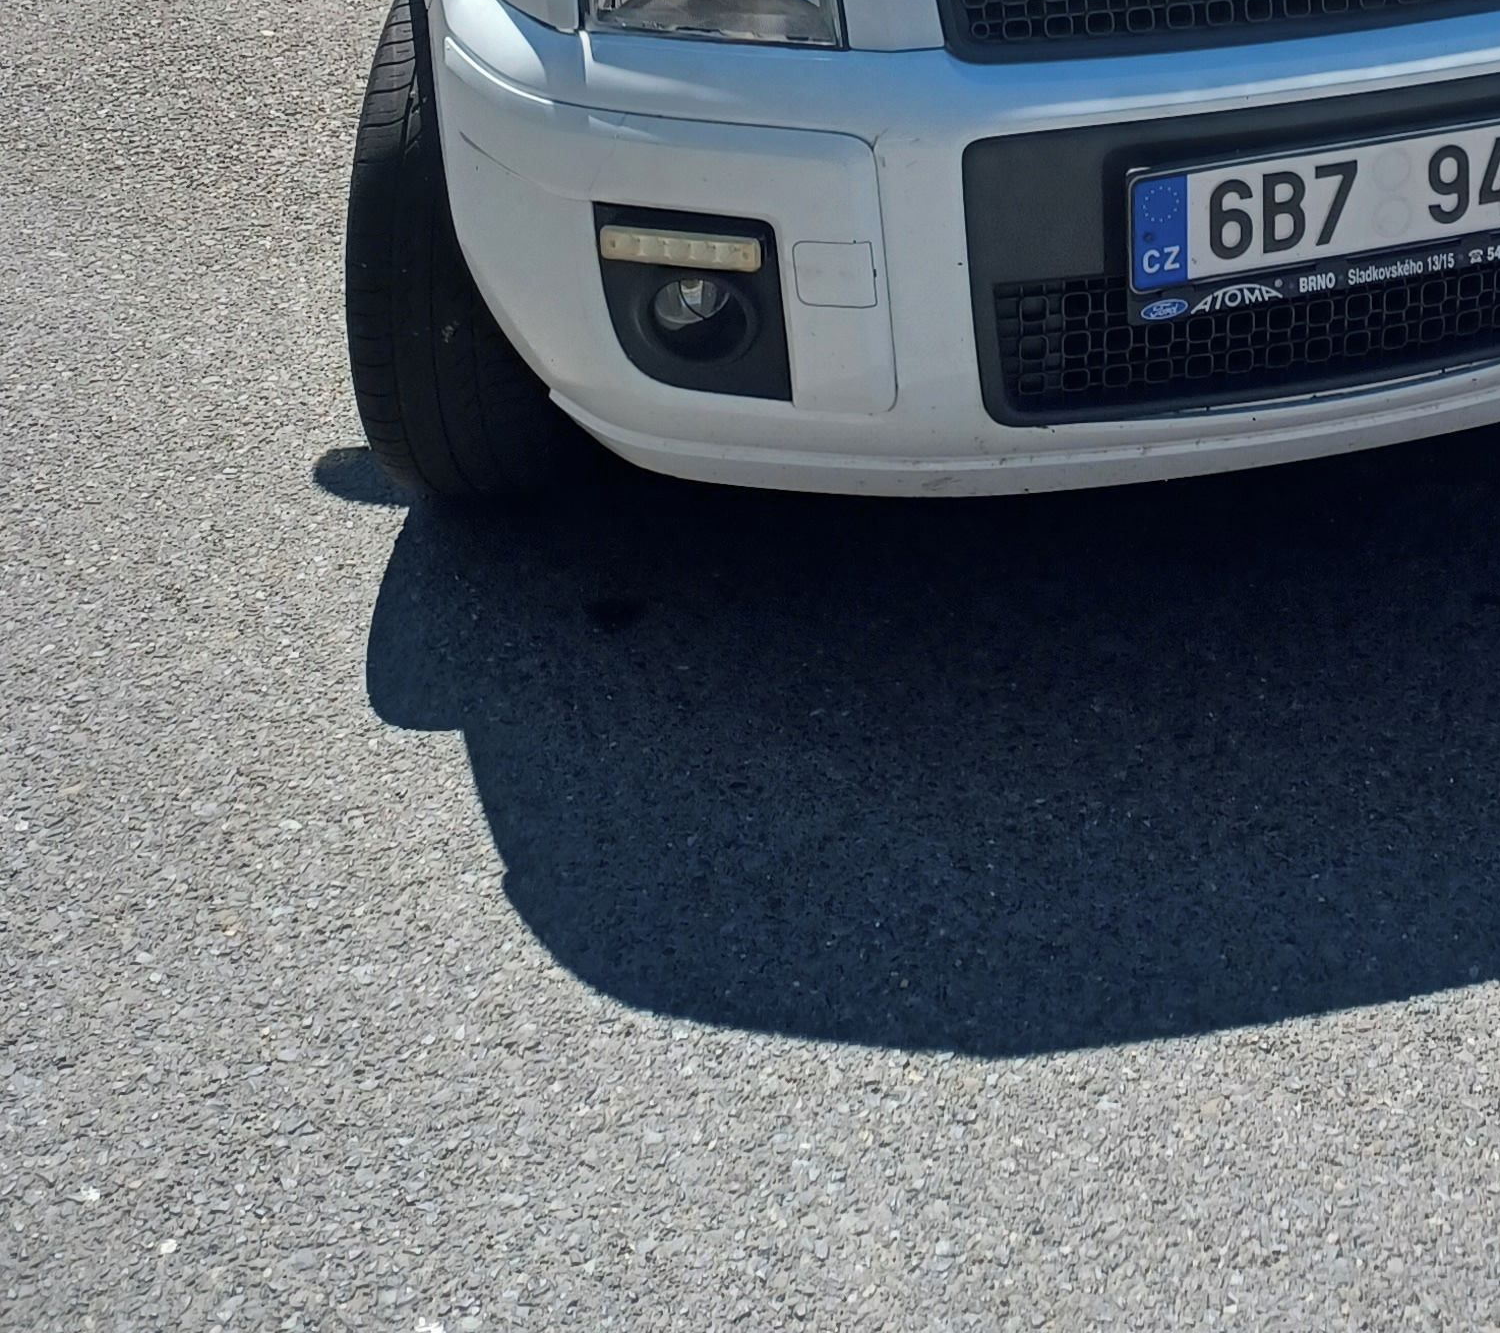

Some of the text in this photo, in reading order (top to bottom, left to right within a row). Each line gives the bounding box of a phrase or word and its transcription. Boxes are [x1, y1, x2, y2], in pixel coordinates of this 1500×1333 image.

[1208, 159, 1359, 260] 6B7
[1142, 245, 1181, 274] CZ
[1191, 283, 1283, 314] ATOMA
[1299, 272, 1336, 293] BRNO
[1348, 257, 1424, 286] Sladkovského
[1427, 253, 1455, 273] 13/15
